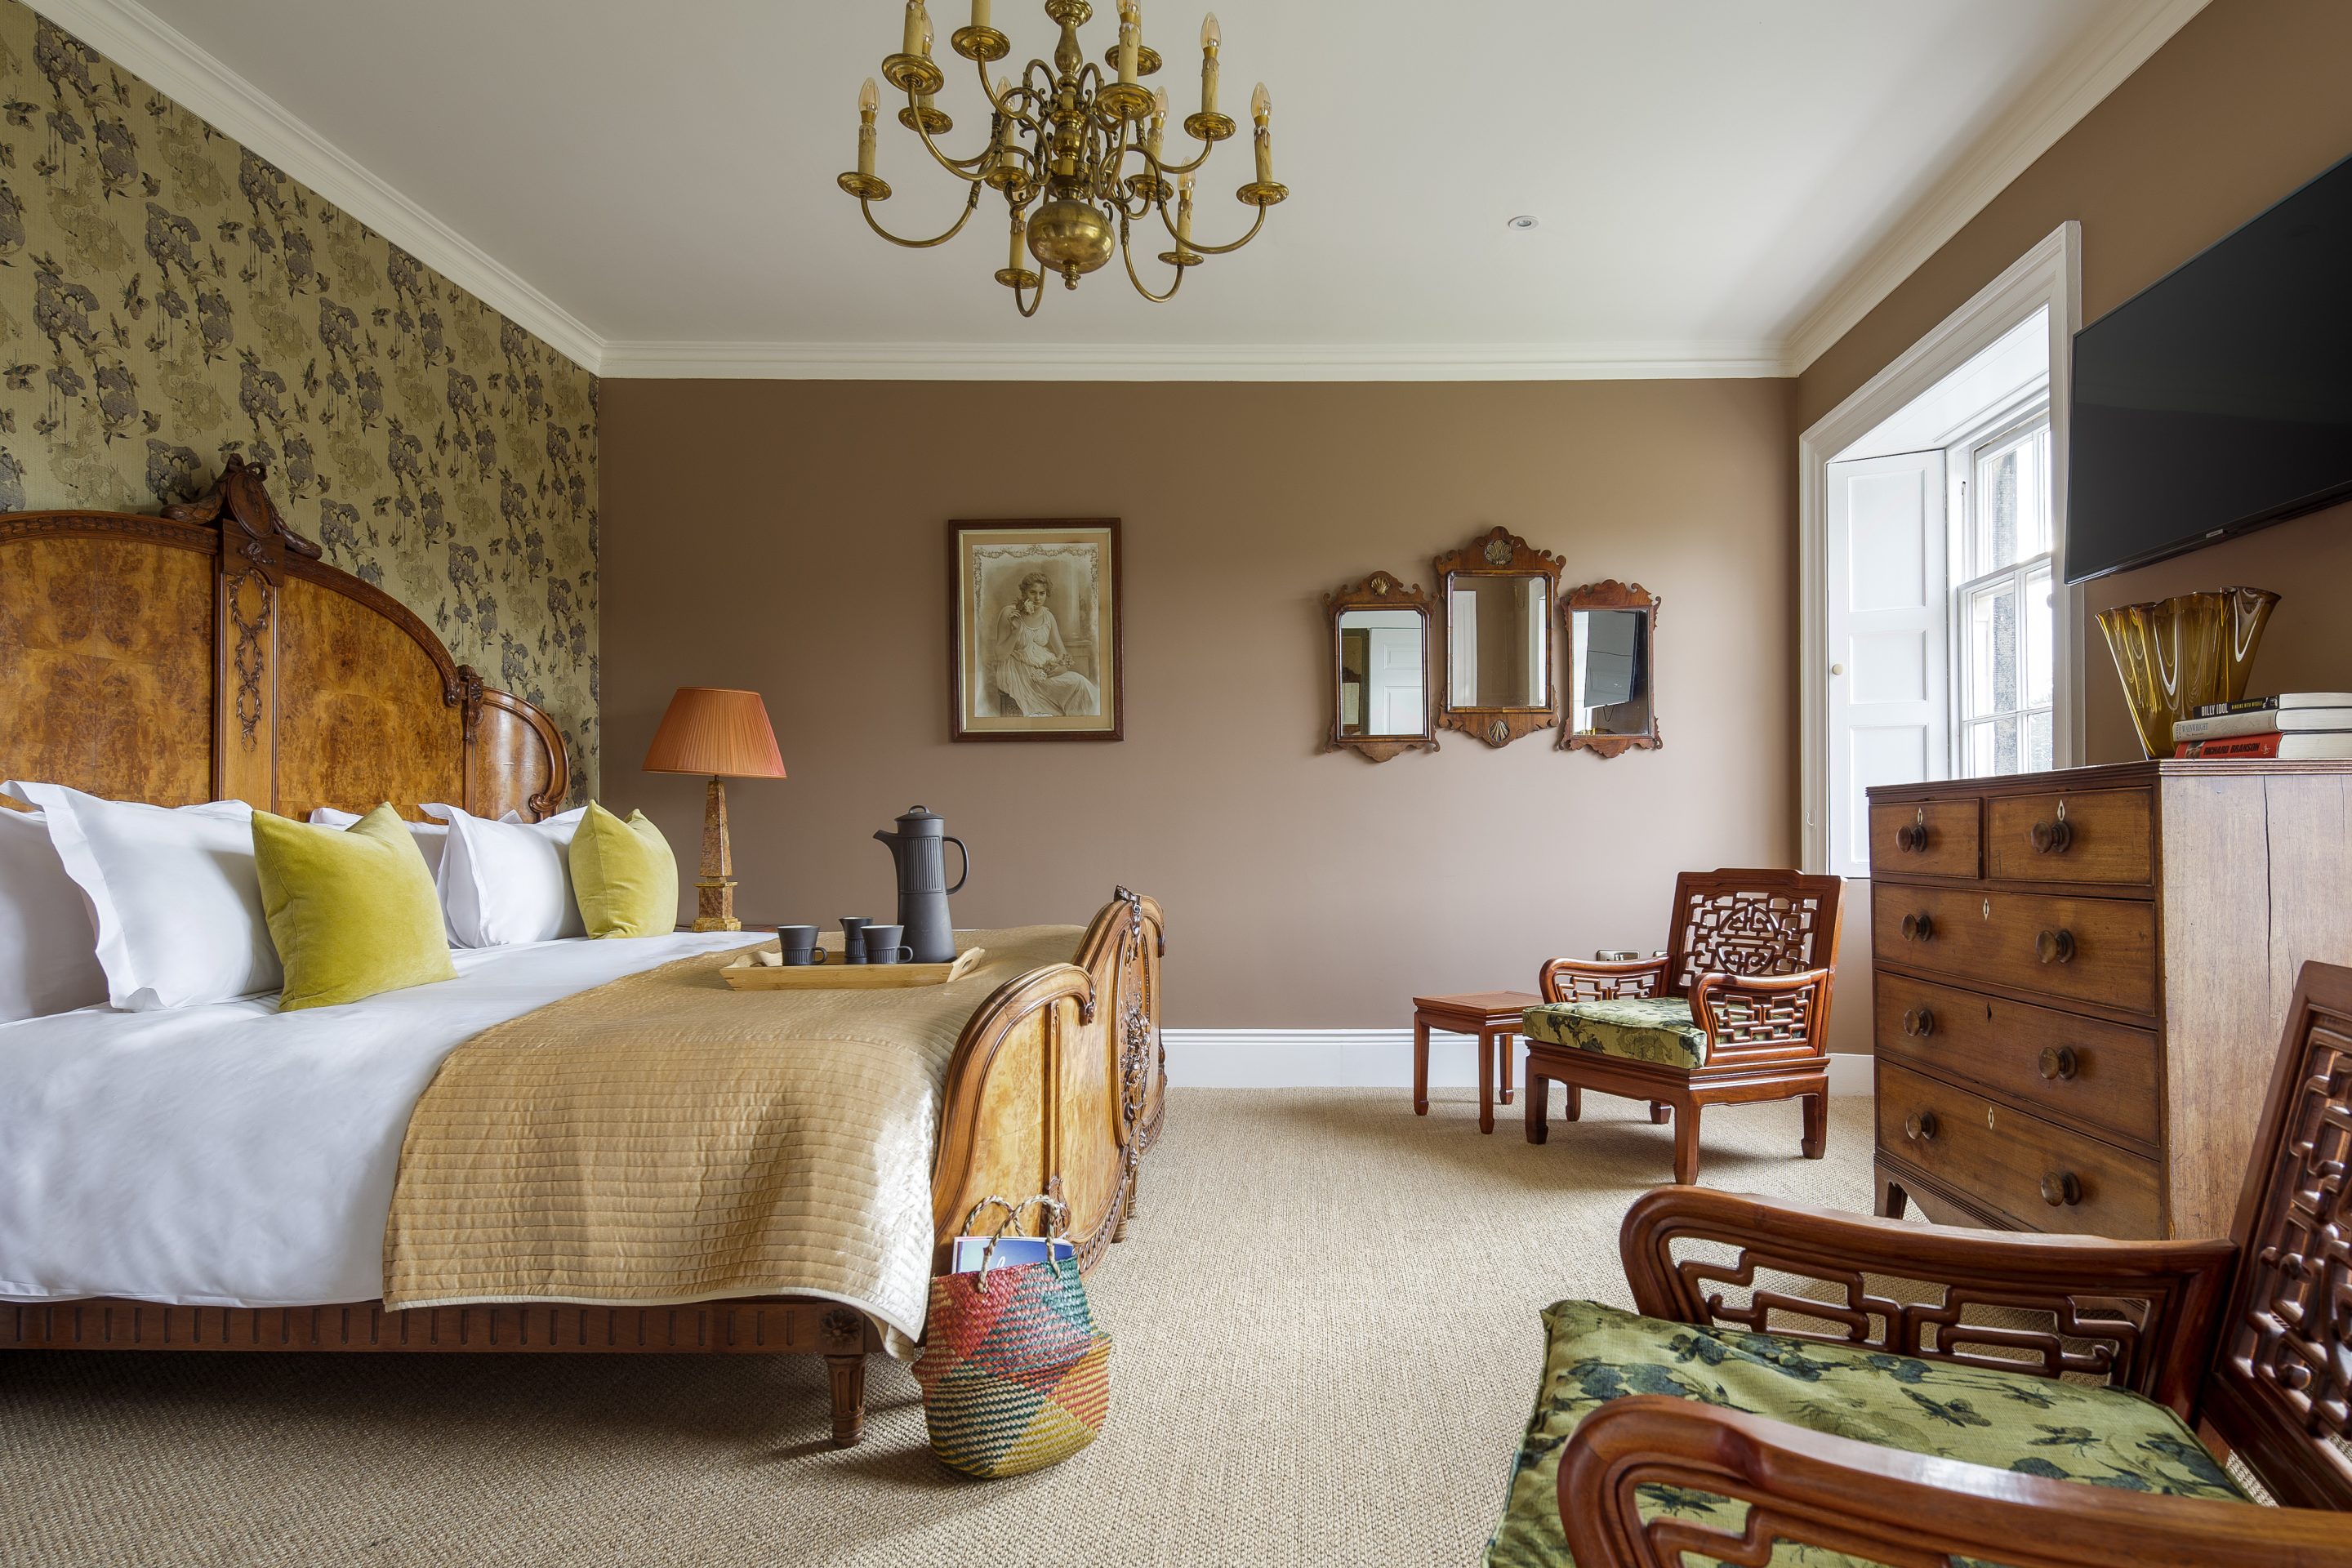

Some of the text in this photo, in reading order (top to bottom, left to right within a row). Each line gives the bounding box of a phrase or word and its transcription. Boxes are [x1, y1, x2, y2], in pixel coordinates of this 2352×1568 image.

[2201, 702, 2229, 716] BILLY IDOL
[2203, 742, 2261, 755] RICHARD BRANSON
